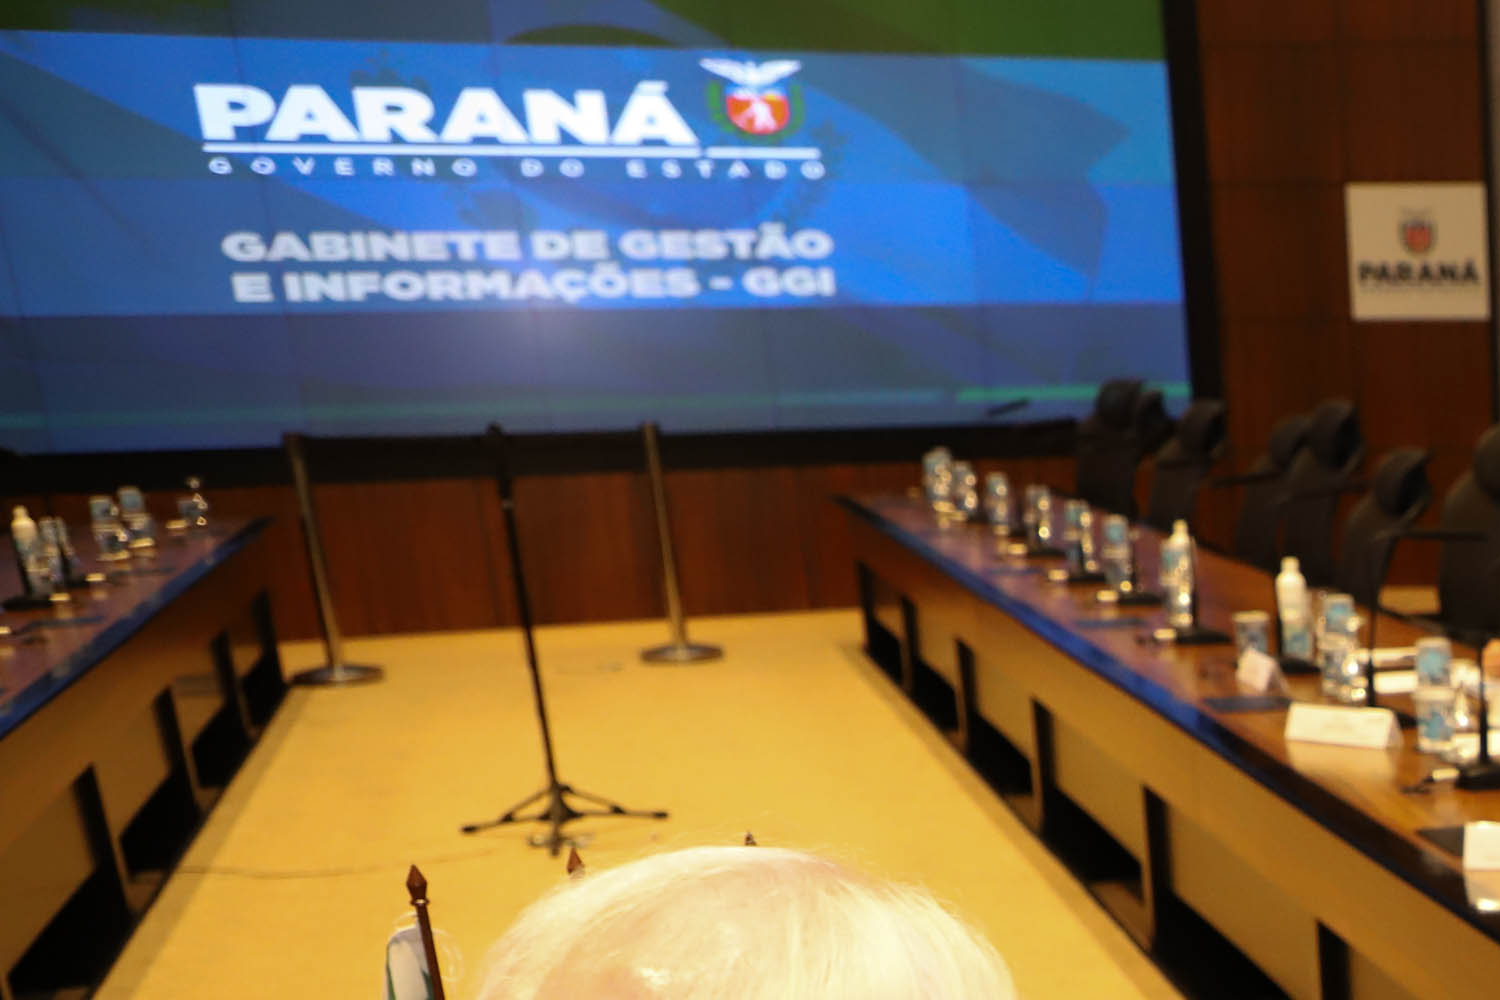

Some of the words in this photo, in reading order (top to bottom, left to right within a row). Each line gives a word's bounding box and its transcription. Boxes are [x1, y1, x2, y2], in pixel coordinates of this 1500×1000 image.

[193, 80, 699, 145] PARANÁ
[207, 156, 478, 177] GOVERNO
[520, 157, 585, 179] DO
[625, 158, 826, 180] ESTADO
[221, 231, 522, 262] GABINETE
[530, 230, 609, 260] DE
[618, 222, 835, 260] GESTÃO
[231, 271, 275, 302] E
[282, 260, 701, 303] INFORMAÇÕES
[741, 266, 837, 297] GGI
[1358, 259, 1479, 284] PARANÁ
